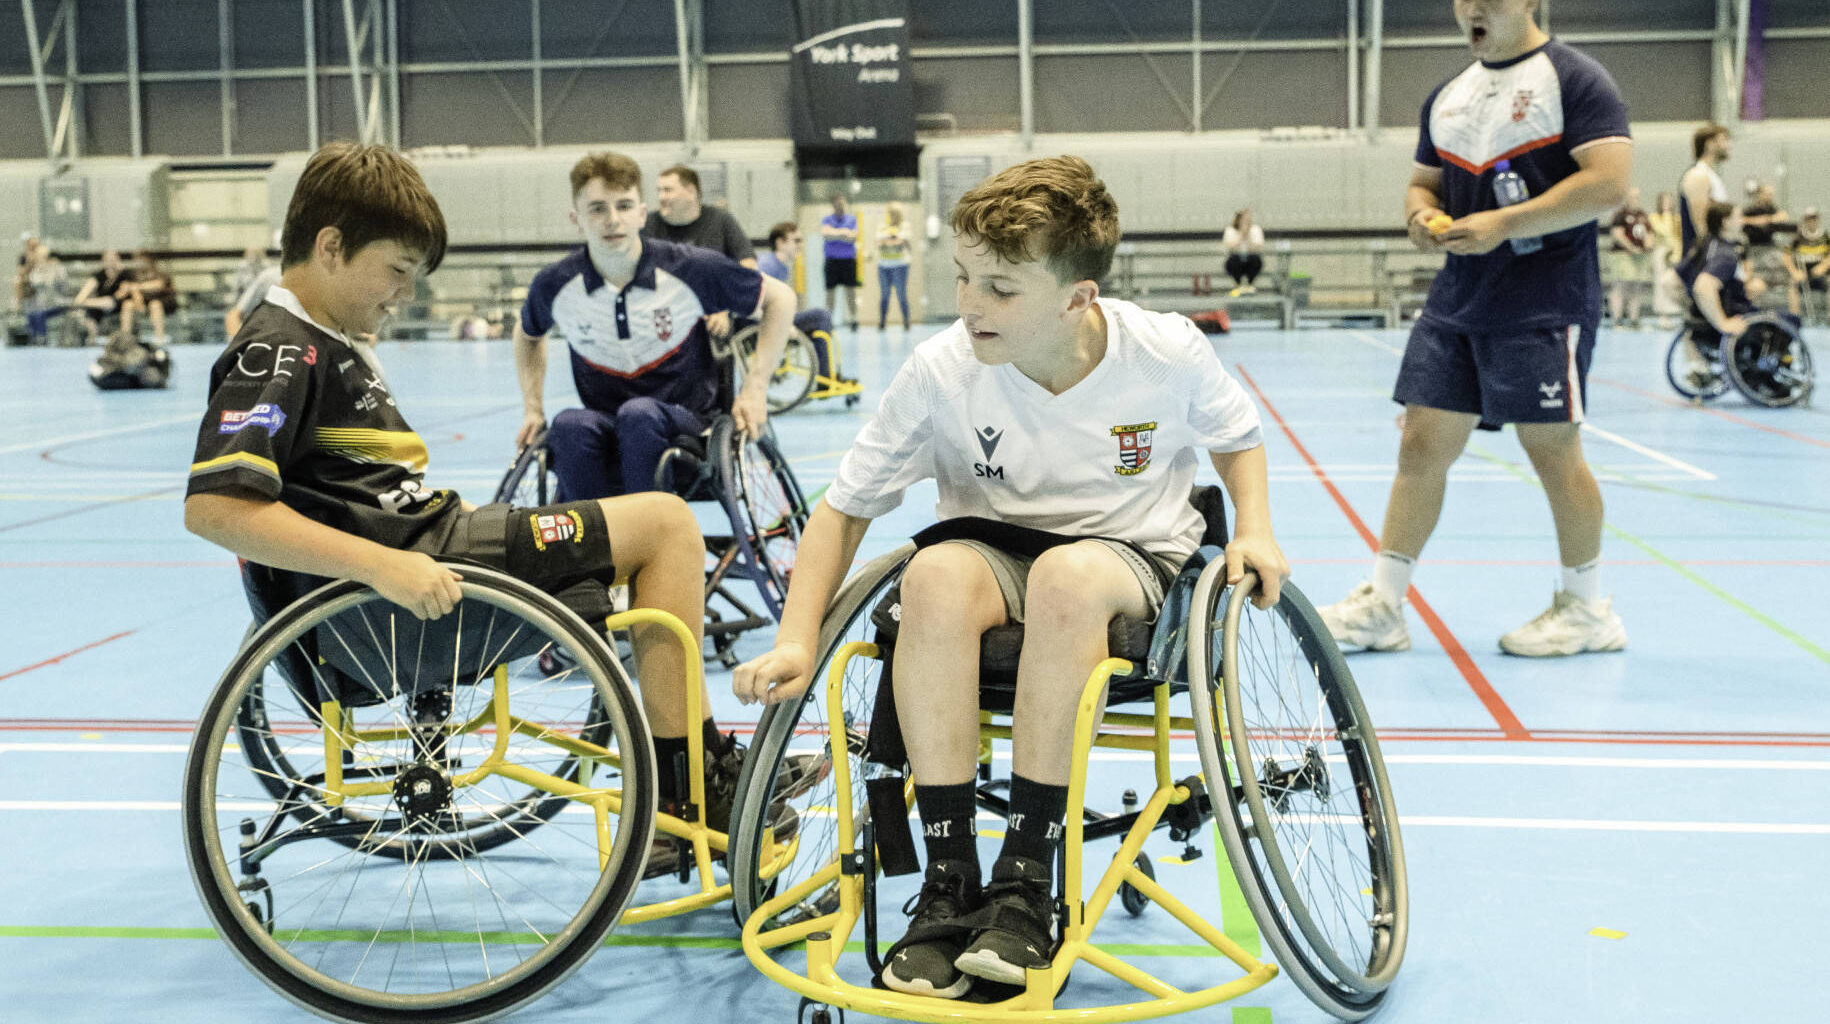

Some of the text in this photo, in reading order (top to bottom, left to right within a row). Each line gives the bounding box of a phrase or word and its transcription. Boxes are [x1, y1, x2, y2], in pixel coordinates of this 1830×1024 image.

[811, 43, 899, 65] York Sport
[974, 462, 1004, 480] SM
